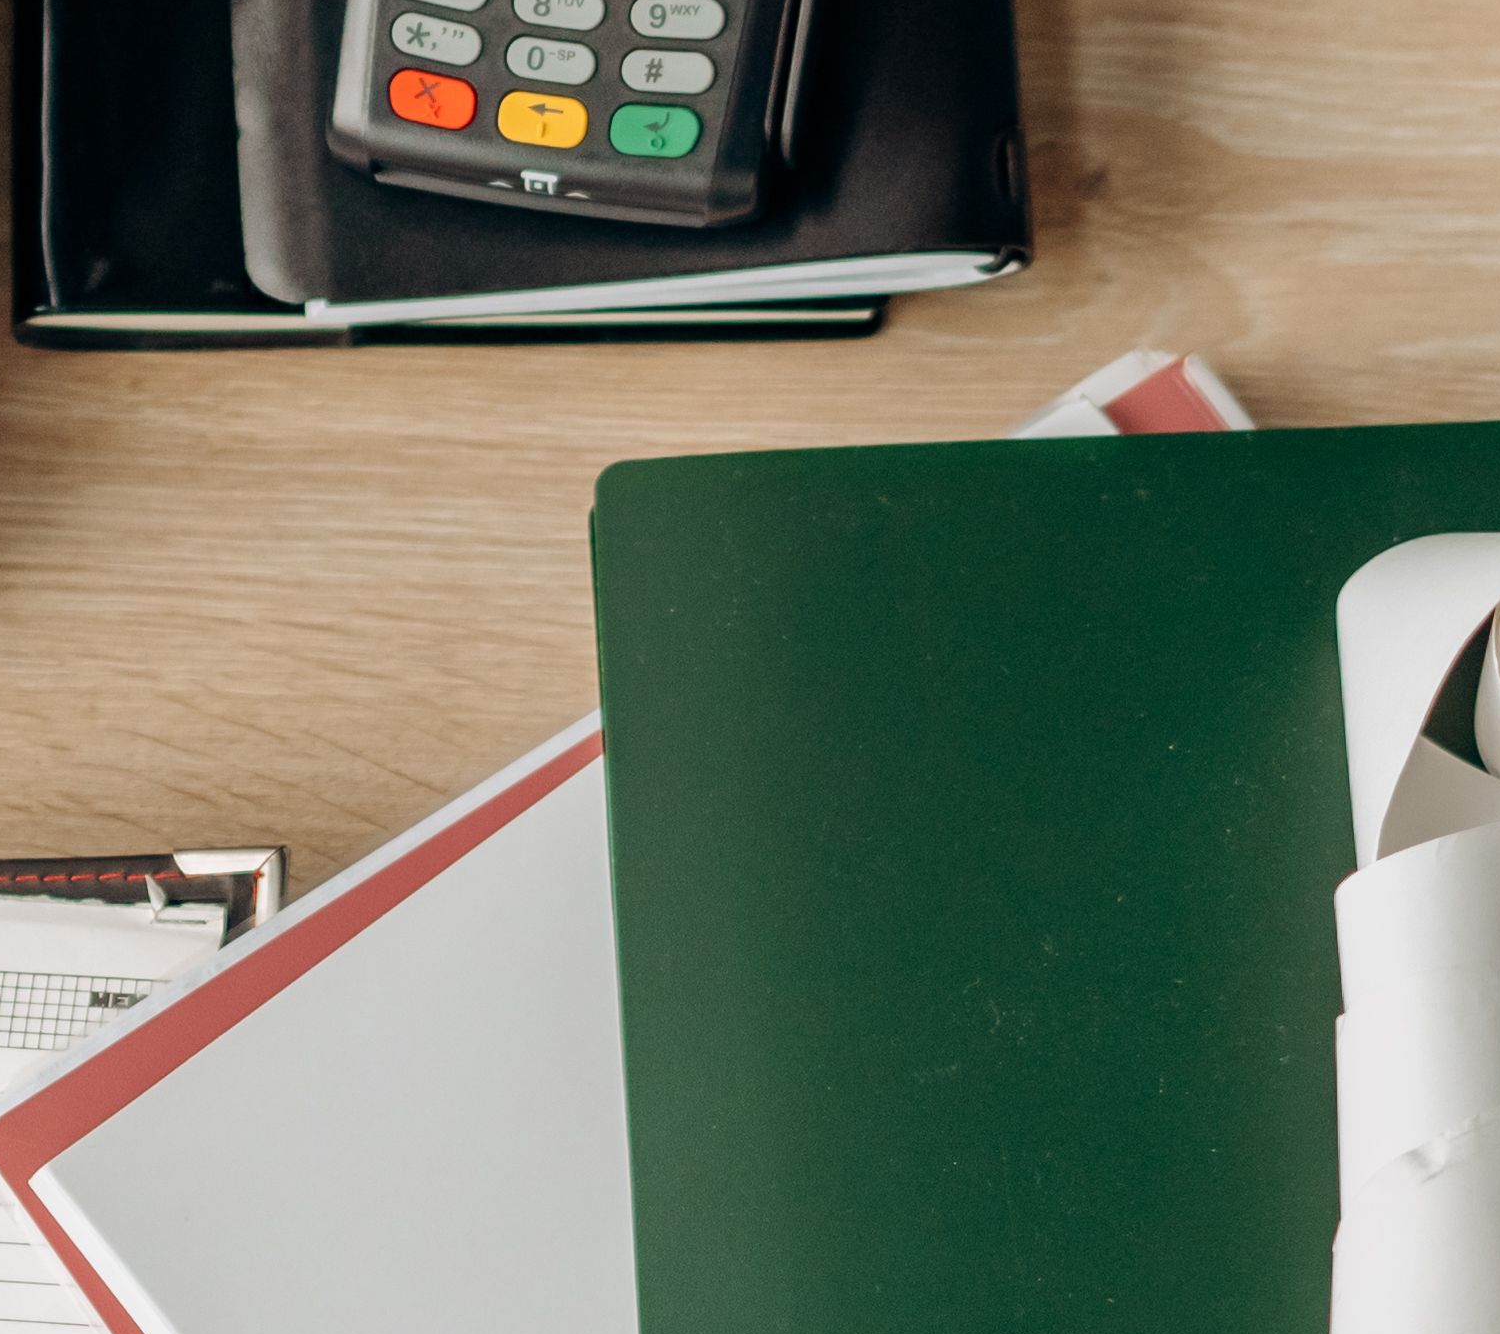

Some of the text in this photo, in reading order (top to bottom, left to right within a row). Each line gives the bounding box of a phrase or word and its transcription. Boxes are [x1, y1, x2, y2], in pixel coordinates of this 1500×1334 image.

[648, 3, 701, 29] 9 WXY
[526, 45, 545, 71] 0
[643, 57, 664, 84] #
